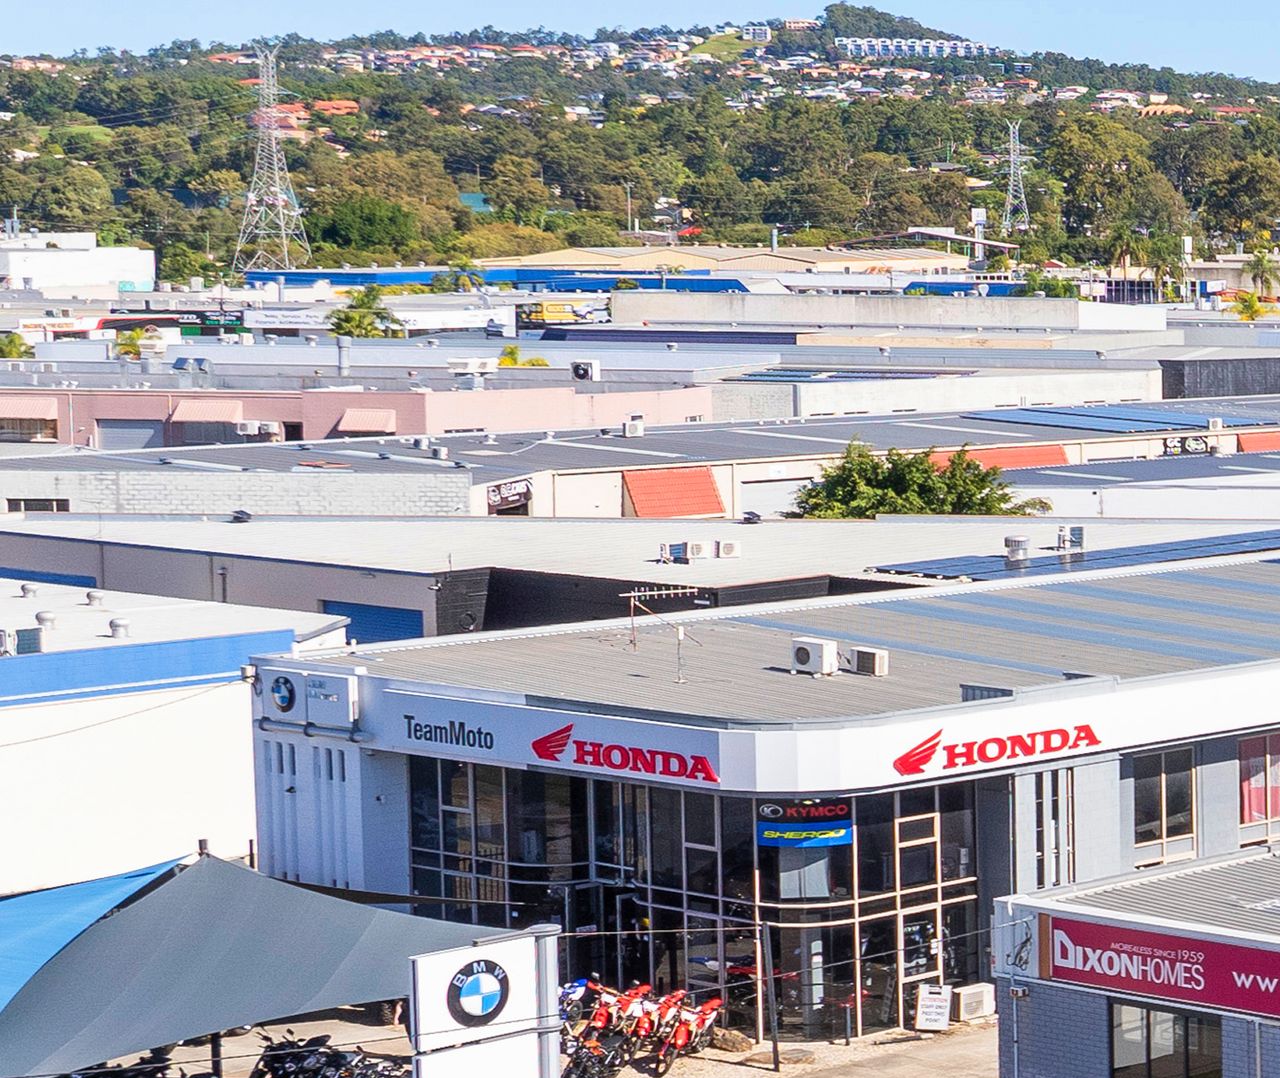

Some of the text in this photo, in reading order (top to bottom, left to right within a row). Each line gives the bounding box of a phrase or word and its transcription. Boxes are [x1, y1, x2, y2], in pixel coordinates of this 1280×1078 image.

[403, 714, 495, 750] TeamMoto
[943, 724, 1102, 769] HONDA
[573, 739, 721, 783] HONDA
[786, 803, 849, 818] KYMCO
[1153, 948, 1177, 959] SINCE
[1177, 949, 1206, 963] 1959
